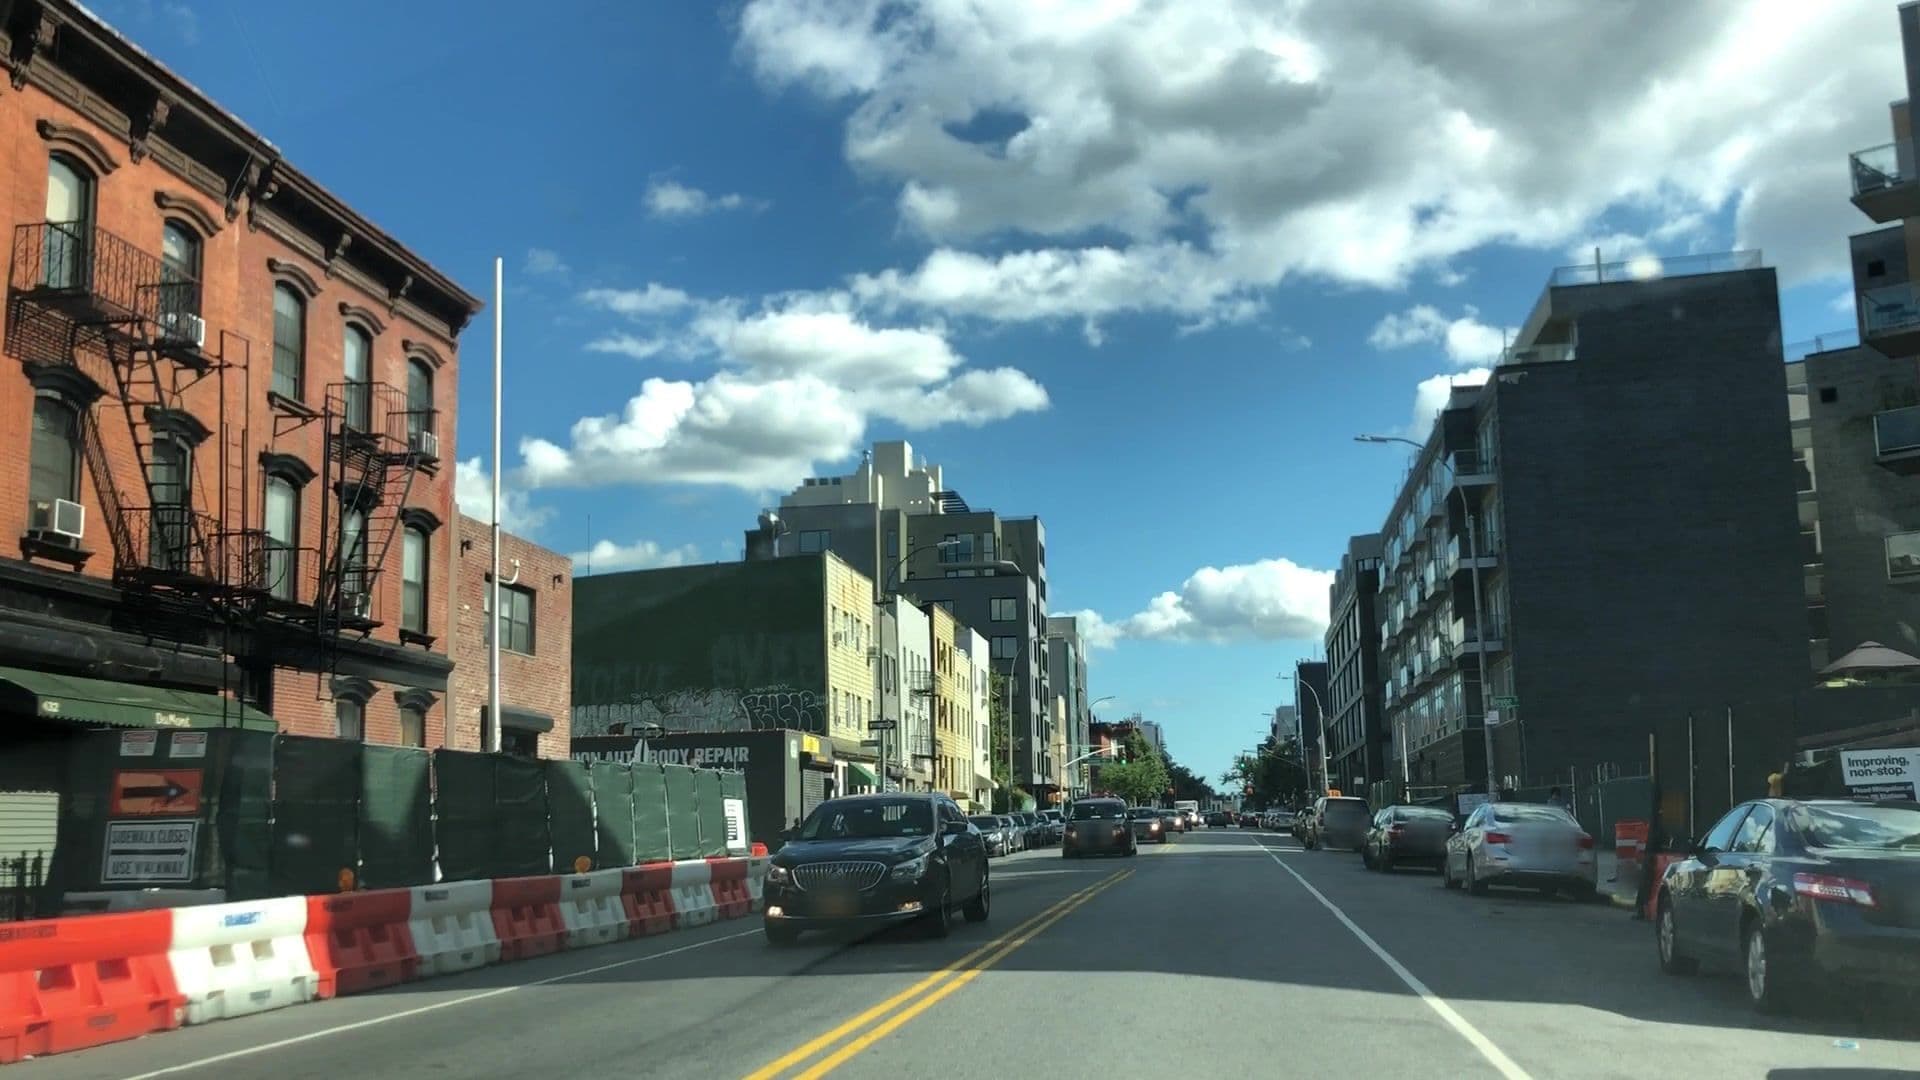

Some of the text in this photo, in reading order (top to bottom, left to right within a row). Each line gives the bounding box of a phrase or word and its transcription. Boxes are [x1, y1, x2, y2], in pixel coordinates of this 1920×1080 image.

[155, 712, 192, 727] DuMont
[651, 747, 690, 764] BODY
[695, 746, 750, 763] REPAIR
[1847, 755, 1910, 768] Improving,
[1849, 767, 1907, 778] non-stop.
[112, 829, 190, 843] SIDEWALK CLOSED
[112, 861, 184, 874] USE WALKWAY
